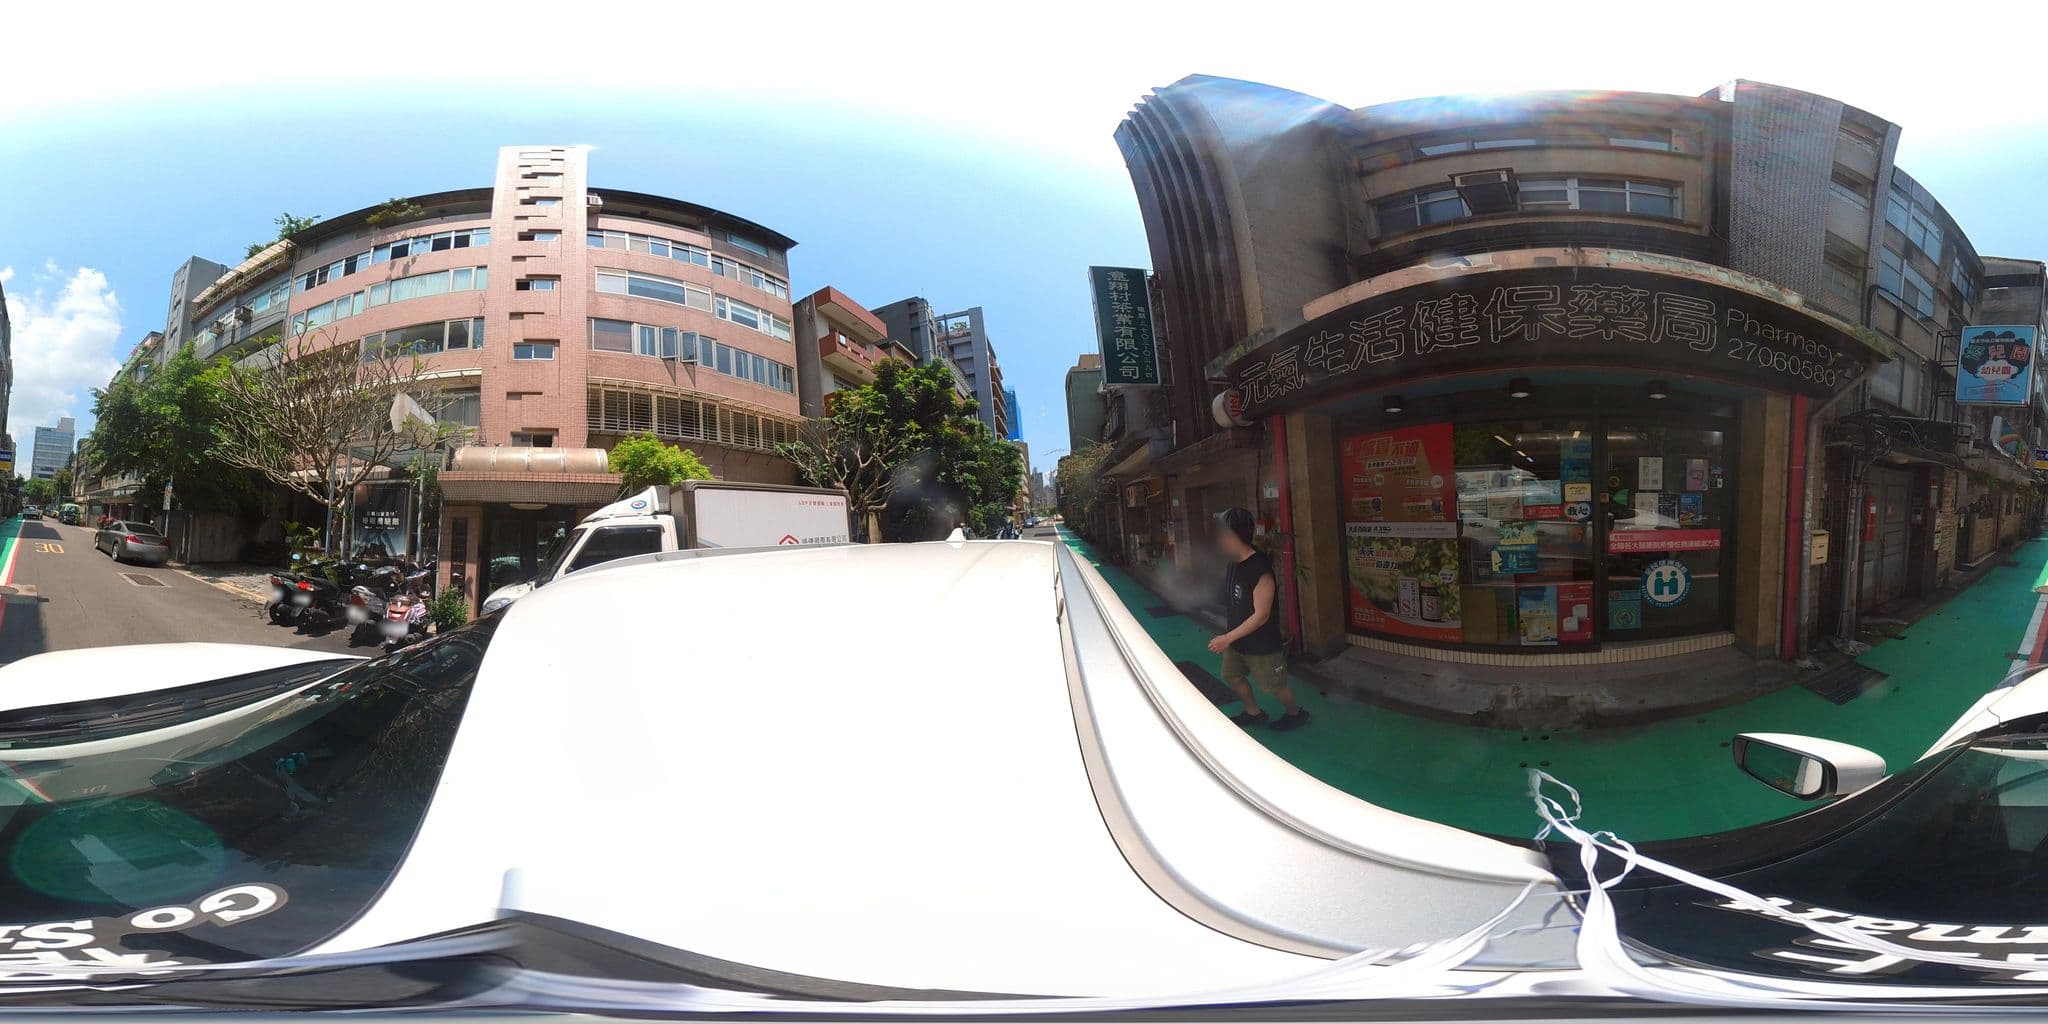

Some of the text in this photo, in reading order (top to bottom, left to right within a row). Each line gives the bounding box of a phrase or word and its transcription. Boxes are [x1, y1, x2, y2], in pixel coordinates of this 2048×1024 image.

[1239, 283, 1717, 411] 元氣生活健保藥局
[1727, 308, 1843, 363] Pharmacy
[1728, 338, 1836, 388] 27060580
[34, 542, 65, 554] 30
[130, 885, 277, 929] Go
